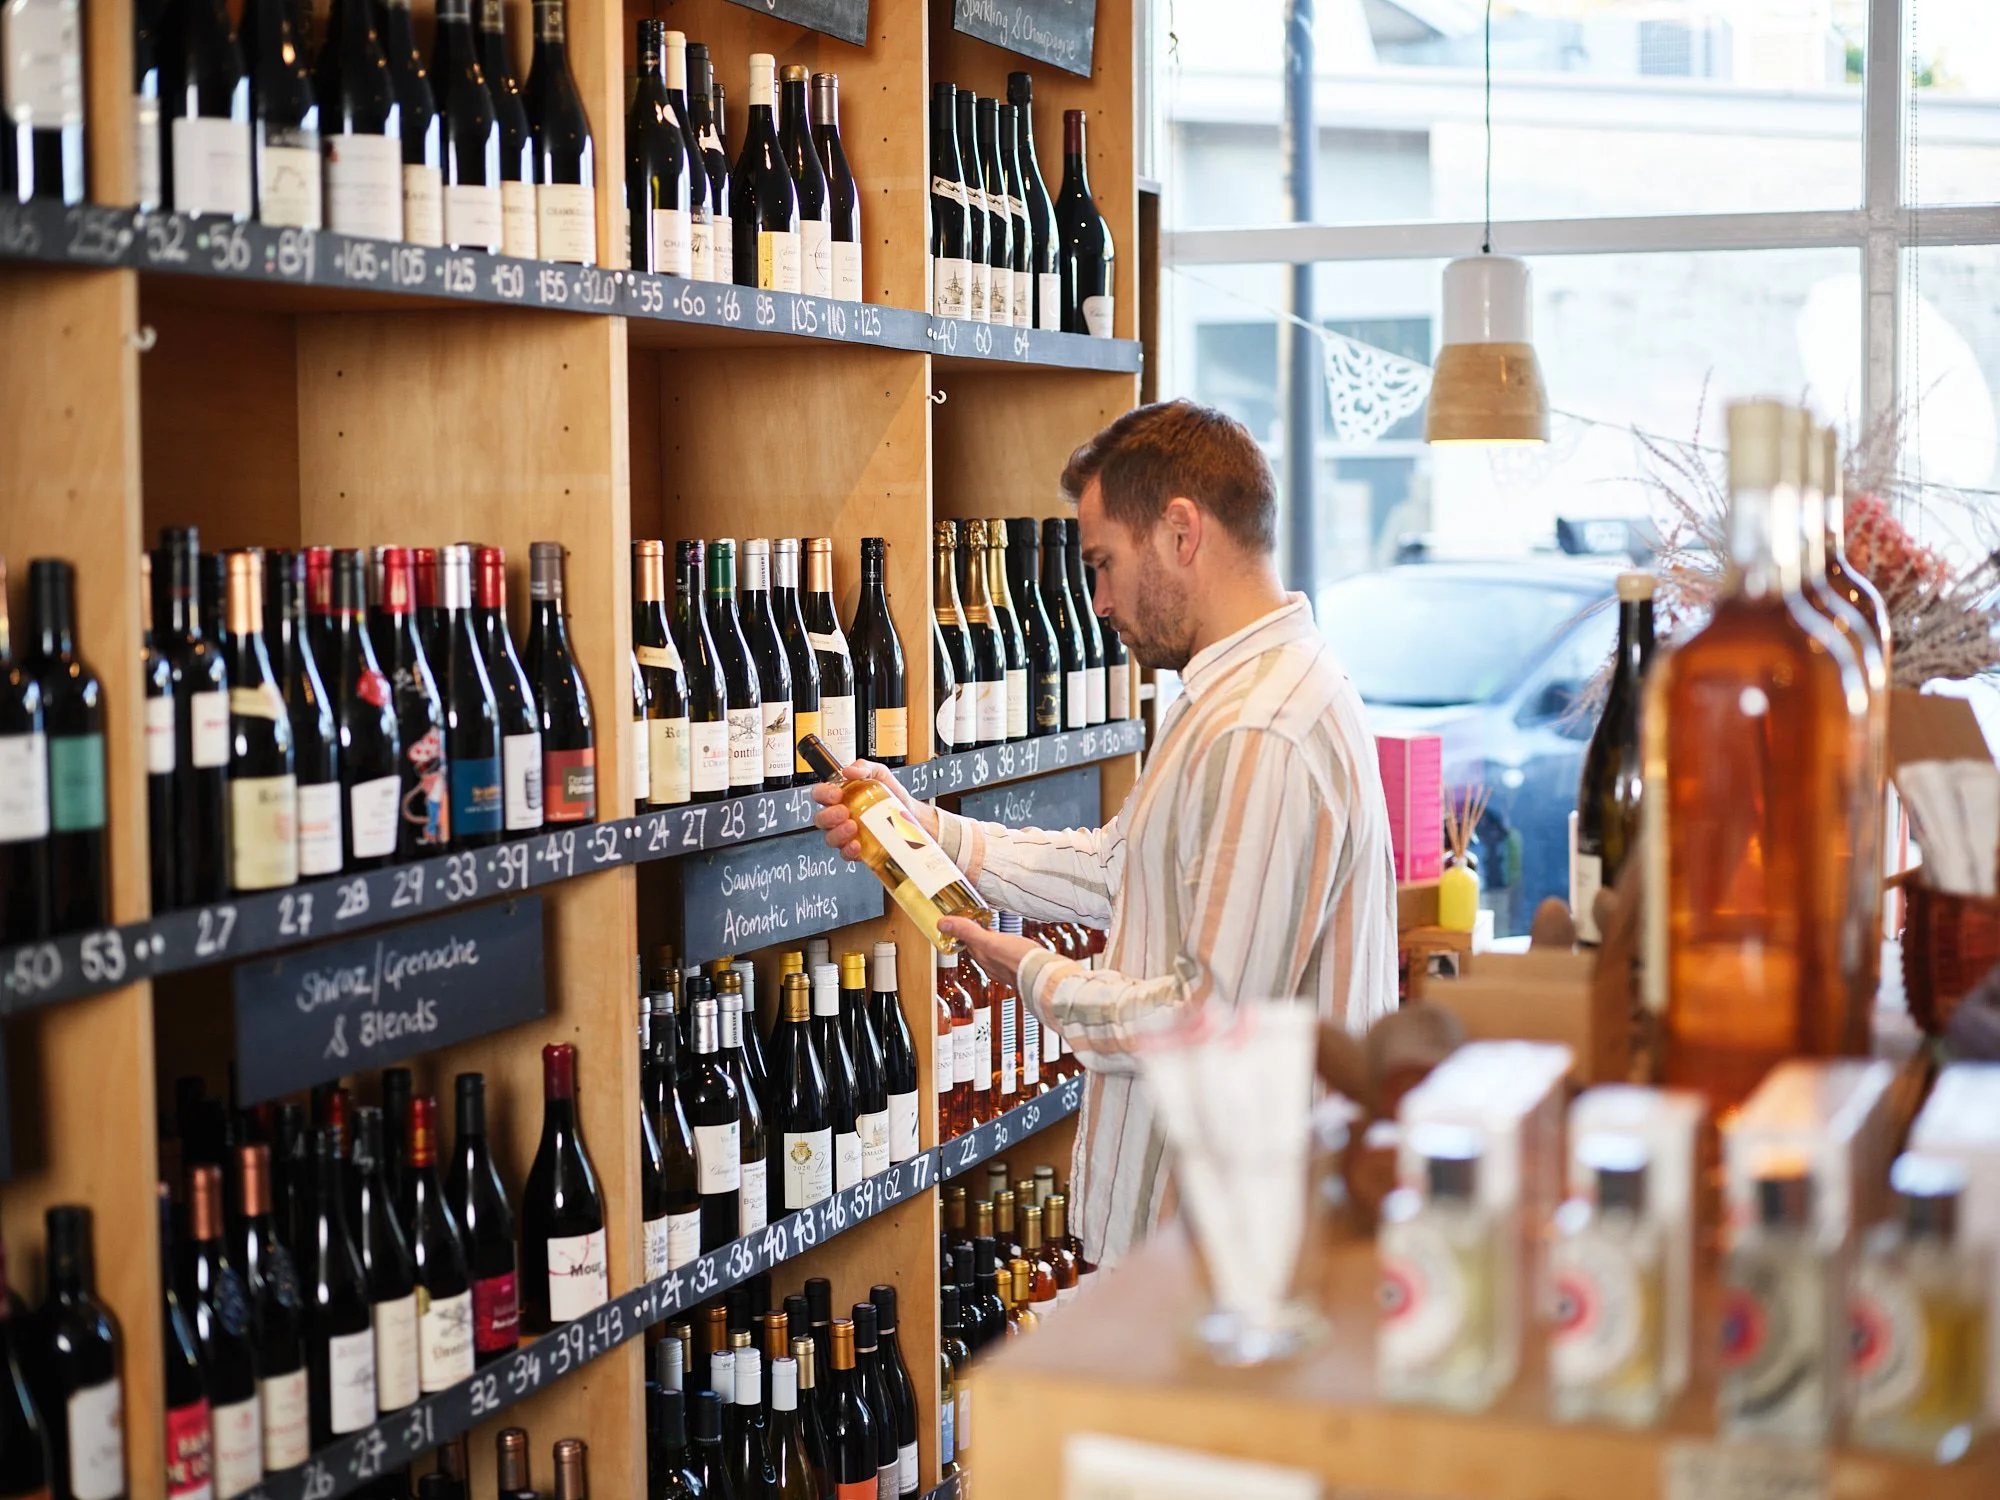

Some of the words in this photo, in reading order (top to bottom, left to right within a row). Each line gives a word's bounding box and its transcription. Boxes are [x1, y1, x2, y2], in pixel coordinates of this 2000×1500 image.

[208, 221, 251, 271] 56
[344, 240, 378, 281] 105
[391, 245, 427, 286] 105
[444, 257, 477, 293] 125
[540, 269, 569, 303] 155
[640, 281, 664, 313] 55
[680, 285, 706, 317] 60
[723, 292, 741, 322] 66
[755, 293, 776, 326] 85
[791, 299, 818, 333] 105
[827, 303, 847, 337] 110
[860, 306, 882, 337] 125
[938, 319, 957, 355] 40
[975, 324, 993, 355] 60
[949, 759, 963, 787] 35
[972, 754, 989, 785] 36
[997, 746, 1014, 777] 38
[1024, 739, 1041, 773] 47
[1053, 735, 1069, 764] 75
[1103, 728, 1120, 754] 130
[648, 814, 670, 851] 24
[681, 808, 708, 850] 27
[720, 800, 746, 839] 28
[758, 798, 779, 833] 32
[790, 789, 812, 823] 45
[911, 765, 928, 794] 55
[1002, 790, 1036, 823] Rosé
[195, 905, 238, 956] 27
[278, 892, 315, 937] 27
[335, 877, 370, 920] 28
[391, 866, 425, 908] 29
[445, 853, 478, 901] 33
[496, 844, 529, 890] 39
[544, 831, 576, 876] 49
[593, 826, 622, 863] 52
[720, 865, 793, 901] Sauvignon
[796, 854, 837, 881] Blanc
[723, 907, 789, 946] Aromatic
[795, 895, 839, 925] Whites
[359, 998, 439, 1048] Blends
[960, 1134, 977, 1165] 22
[994, 1122, 1008, 1151] 30
[1024, 1106, 1040, 1130] 30
[661, 1271, 684, 1308] 24
[696, 1257, 718, 1293] 32
[730, 1238, 753, 1280] 36
[763, 1225, 787, 1267] 40
[793, 1208, 816, 1252] 43
[826, 1193, 845, 1231] 46
[853, 1179, 874, 1219] 59
[884, 1168, 902, 1200] 62
[910, 1154, 930, 1189] 77
[410, 1405, 435, 1449] 31
[470, 1373, 500, 1416] 32
[515, 1352, 541, 1395] 34
[557, 1324, 585, 1375] 39
[596, 1306, 624, 1347] 43
